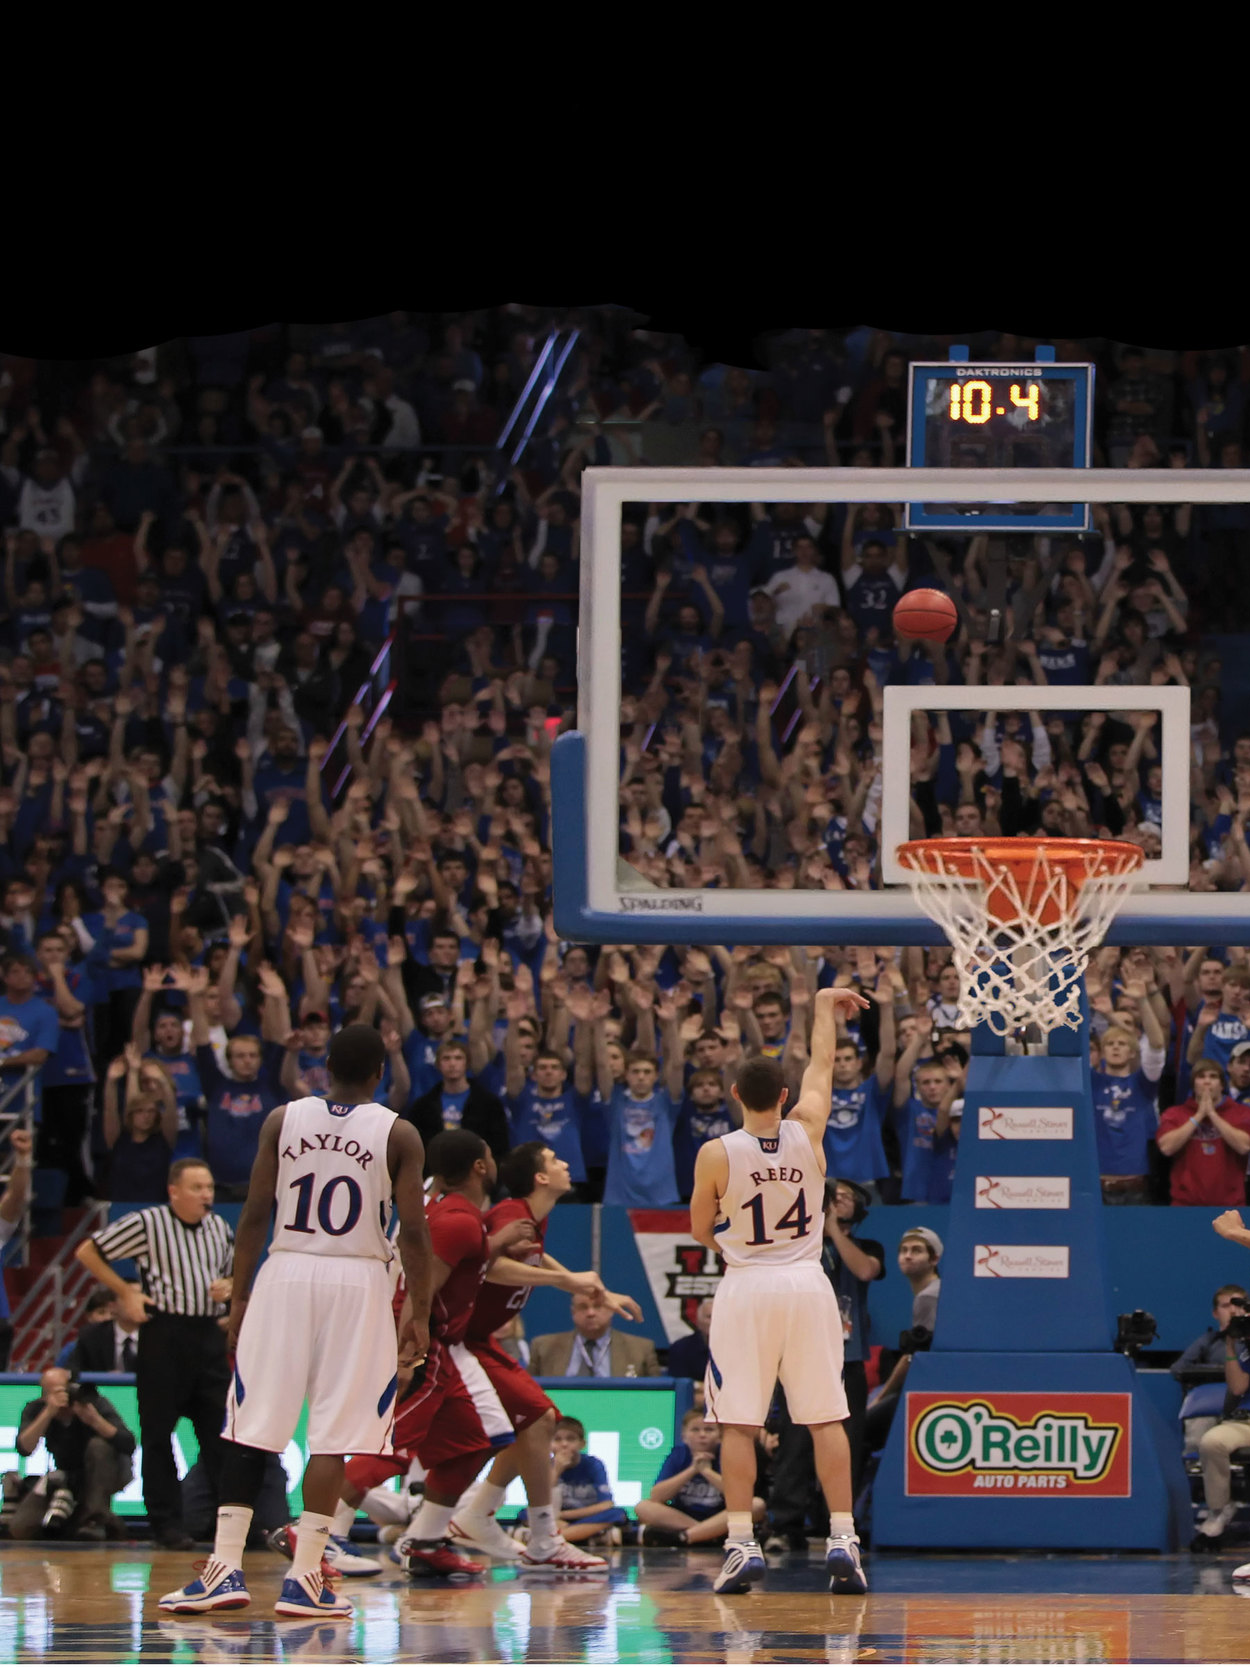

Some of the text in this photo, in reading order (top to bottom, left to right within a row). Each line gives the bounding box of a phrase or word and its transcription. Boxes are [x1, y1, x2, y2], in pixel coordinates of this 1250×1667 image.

[956, 368, 1042, 377] DAKTRONICS
[949, 380, 1039, 424] 10.4
[619, 896, 703, 912] SPALDING
[282, 1134, 373, 1170] TAYLOR
[750, 1167, 803, 1187] REED
[284, 1172, 363, 1236] 10
[741, 1188, 812, 1246] 14
[925, 1412, 1107, 1472] O'Reilly
[972, 1475, 1067, 1488] AUTO PARTS
